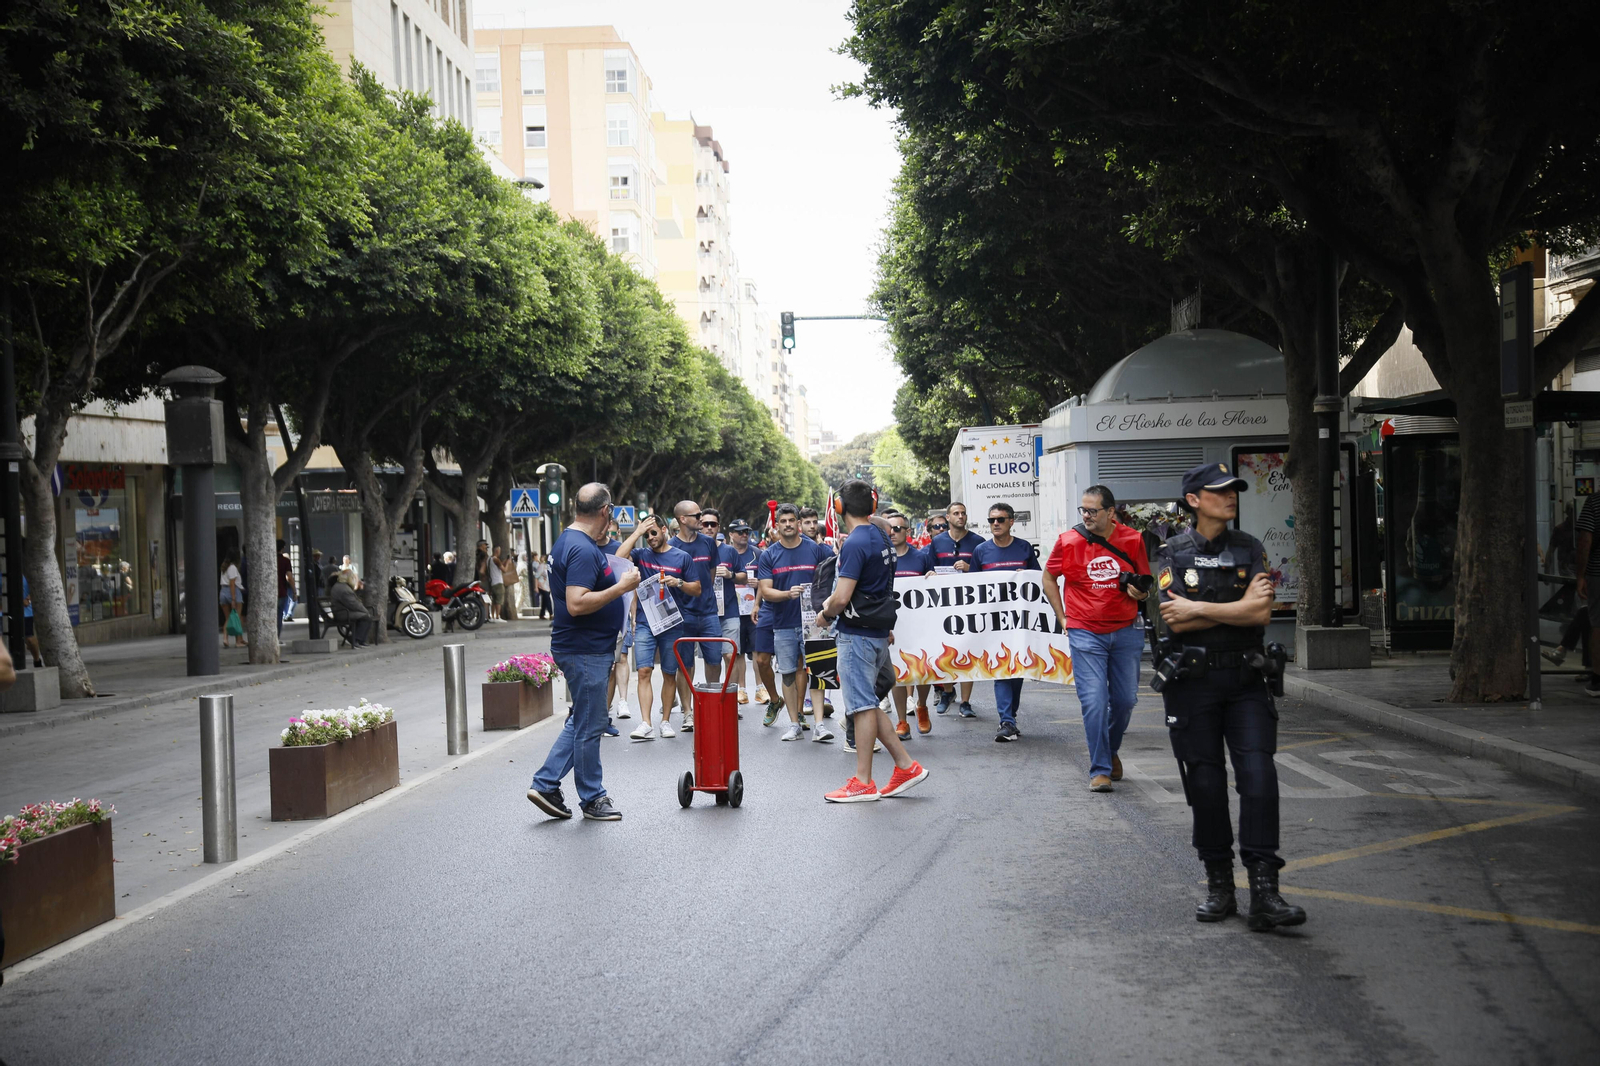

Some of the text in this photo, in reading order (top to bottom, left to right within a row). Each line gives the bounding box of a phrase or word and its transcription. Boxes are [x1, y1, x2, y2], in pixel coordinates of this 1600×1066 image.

[1096, 410, 1268, 432] El Kiosko de las Flores
[988, 452, 1026, 460] MUDANZAS
[989, 461, 1034, 475] EURO
[68, 463, 126, 496] Soloptical
[976, 481, 1020, 489] NACIONALES
[1273, 483, 1290, 491] con
[1261, 527, 1295, 545] flores
[1091, 560, 1114, 570] UGT
[943, 609, 1067, 635] QUEMA
